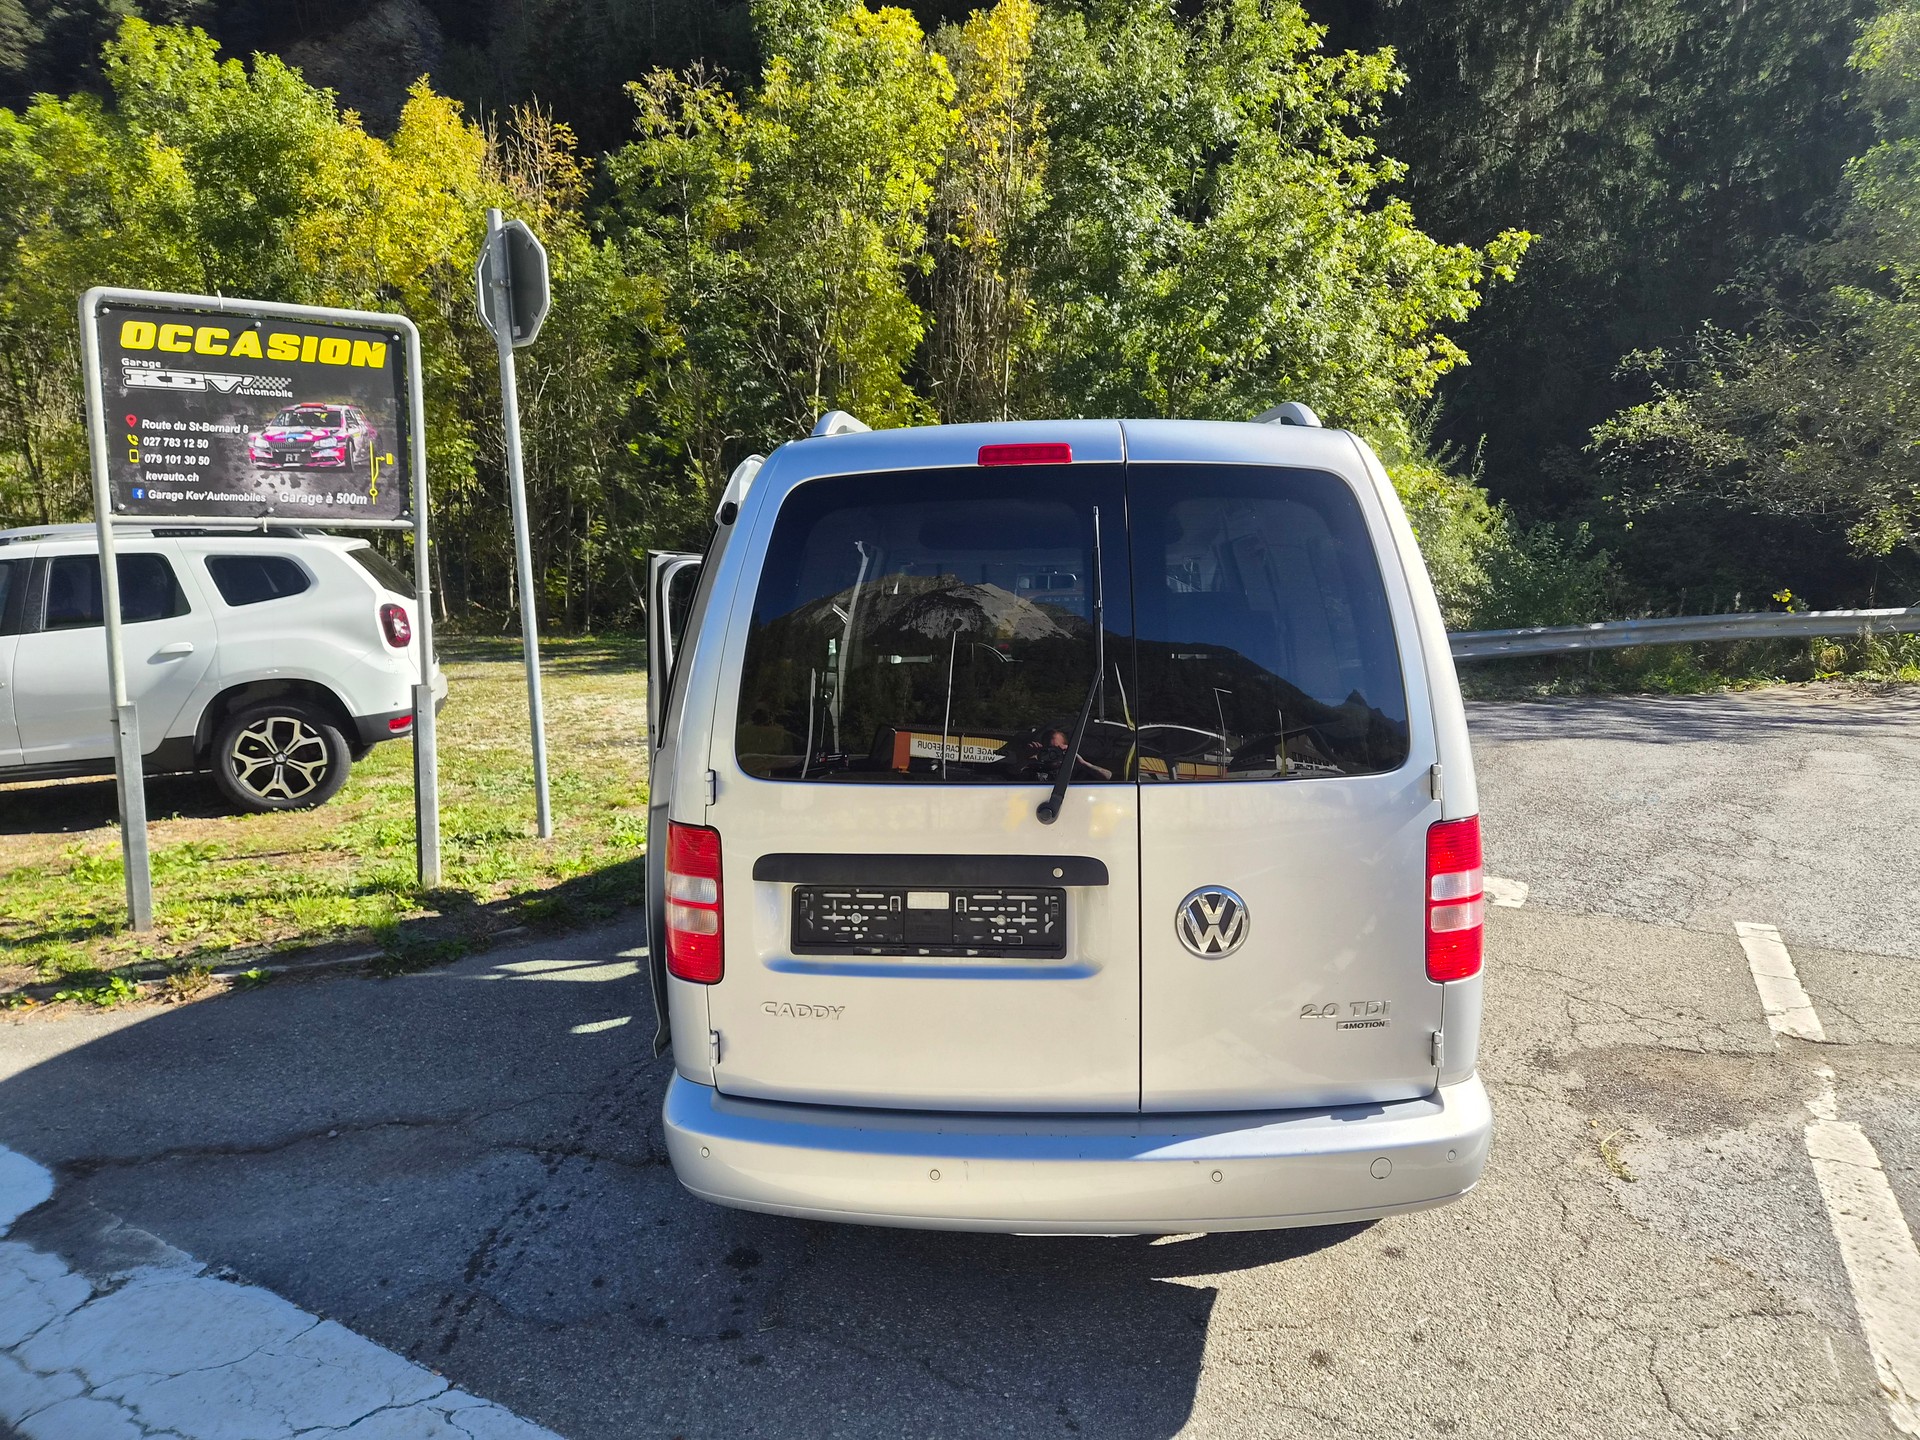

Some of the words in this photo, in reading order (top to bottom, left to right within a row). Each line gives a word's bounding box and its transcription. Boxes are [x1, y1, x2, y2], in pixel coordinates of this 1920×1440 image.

[119, 320, 387, 369] OCCASION
[121, 357, 161, 368] Garage
[235, 387, 293, 398] Automobile
[142, 419, 171, 430] Route
[174, 421, 187, 431] du
[189, 421, 240, 433] St-Bernard
[242, 424, 249, 433] 8
[143, 436, 161, 446] 027
[163, 437, 181, 447] 783
[183, 438, 195, 448] 12
[197, 439, 209, 449] 50
[144, 453, 162, 464] 079
[165, 454, 182, 464] 101
[184, 455, 196, 465] 30
[198, 455, 210, 465] 50
[285, 453, 301, 463] RT
[145, 470, 200, 482] kevauto.ch
[147, 489, 184, 502] Garage
[279, 491, 323, 506] Garage
[325, 491, 333, 504] à
[336, 492, 368, 505] 500m
[760, 1001, 846, 1020] CADDY
[1299, 1002, 1340, 1020] 2.0
[1349, 1000, 1392, 1017] TDI
[1342, 1021, 1386, 1030] 4MOTION
